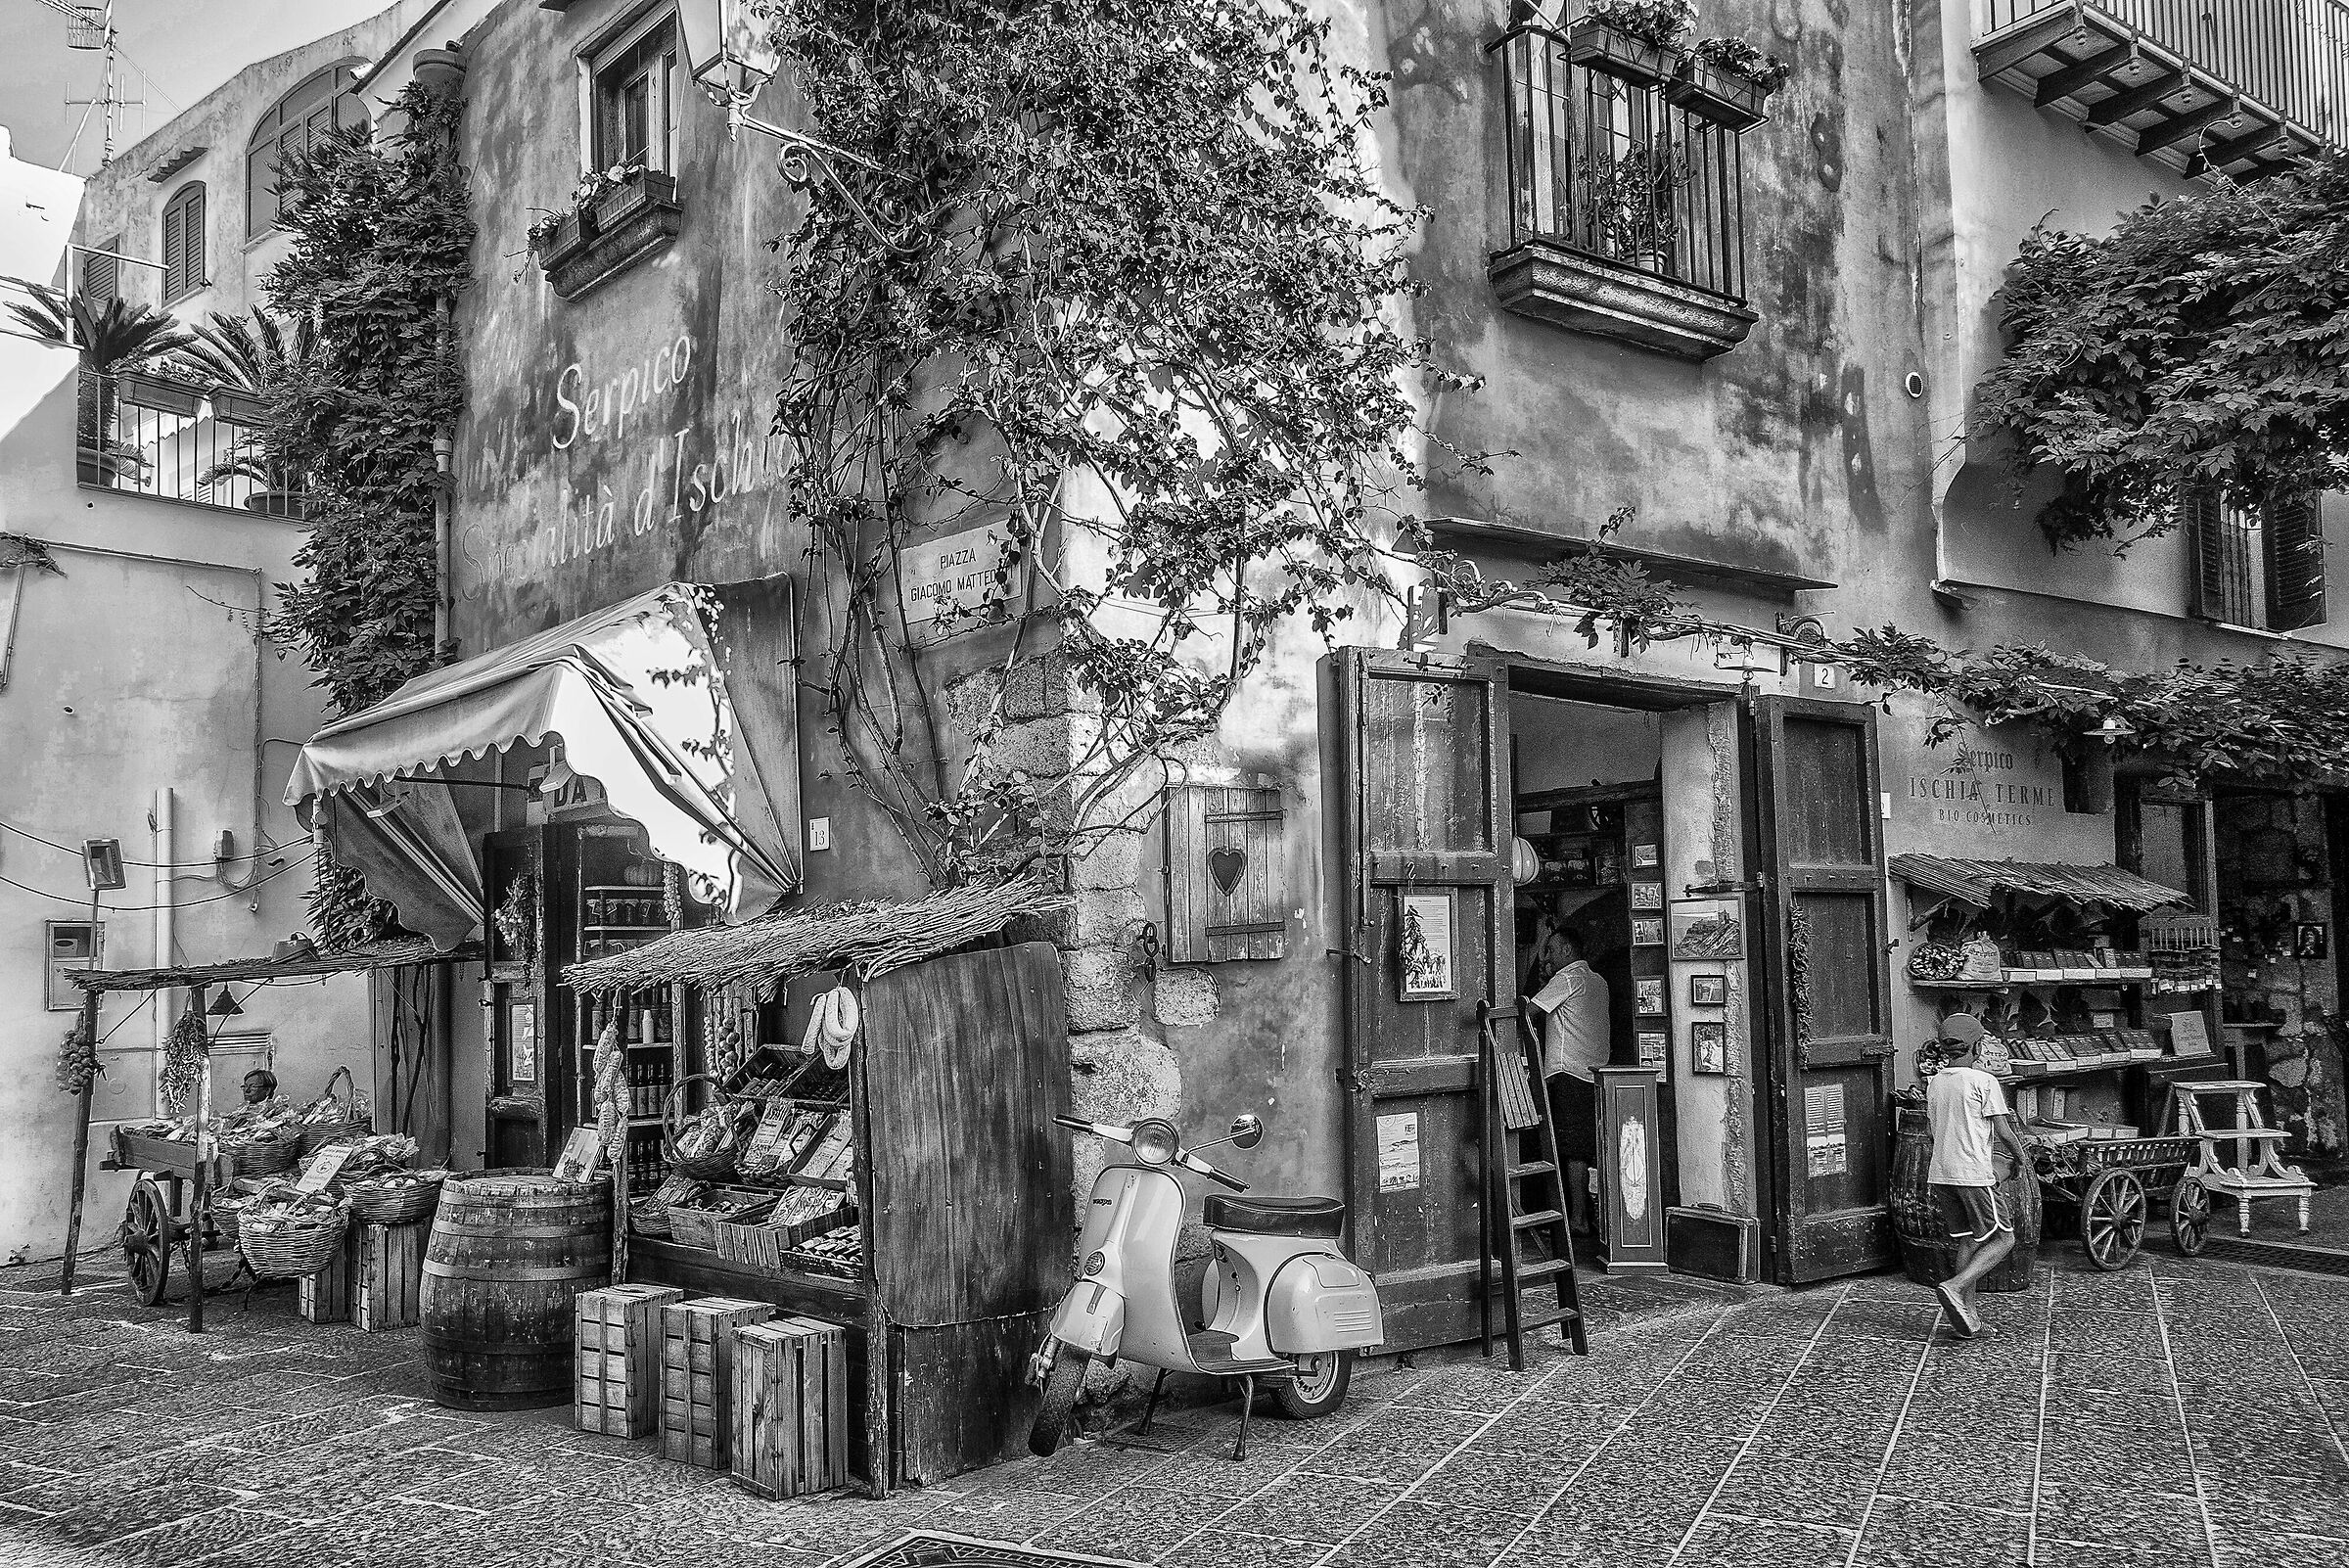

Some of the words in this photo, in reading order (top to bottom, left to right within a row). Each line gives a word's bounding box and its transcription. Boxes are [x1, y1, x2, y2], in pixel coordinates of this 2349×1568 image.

[553, 335, 691, 449] Serpico
[940, 547, 977, 570] PIAZZA
[910, 579, 952, 602] GIACOMO
[1821, 668, 1829, 685] 2
[1958, 742, 2014, 773] Serpico
[1910, 776, 1979, 801] ISCHIA
[1995, 783, 2055, 807] TERME
[1938, 808, 1960, 822] BIO
[1966, 810, 2032, 826] COSMETICS
[814, 830, 825, 847] 13
